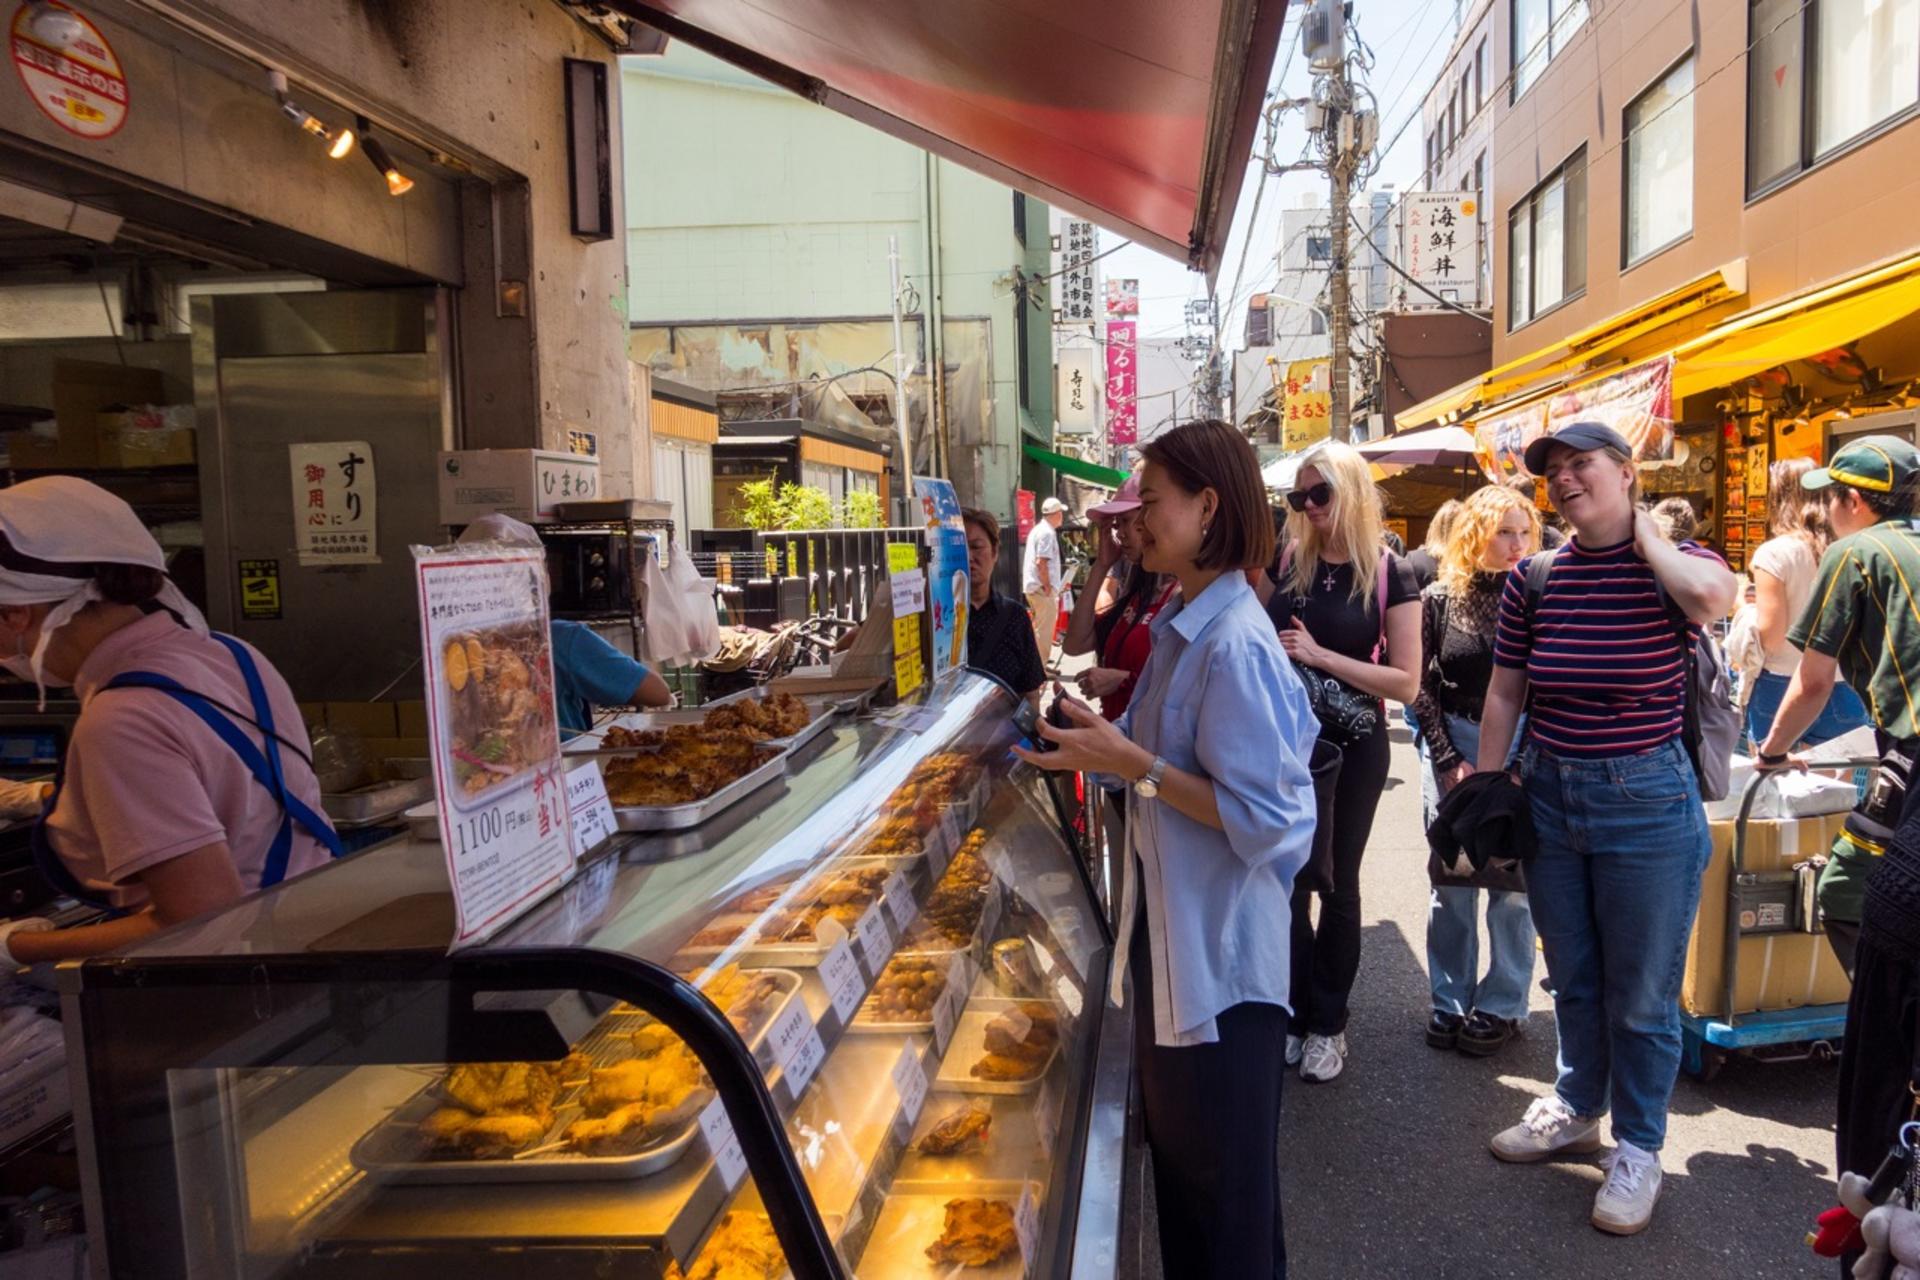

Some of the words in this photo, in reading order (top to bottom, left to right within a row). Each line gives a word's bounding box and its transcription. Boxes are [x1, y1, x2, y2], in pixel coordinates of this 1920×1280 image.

[1069, 222, 1081, 319] 築地場外市場
[1081, 222, 1093, 319] 築地四丁目町会
[304, 464, 326, 526] 御用心
[338, 452, 365, 522] すり
[543, 468, 596, 497] ひまわり
[534, 769, 550, 838] 弁当
